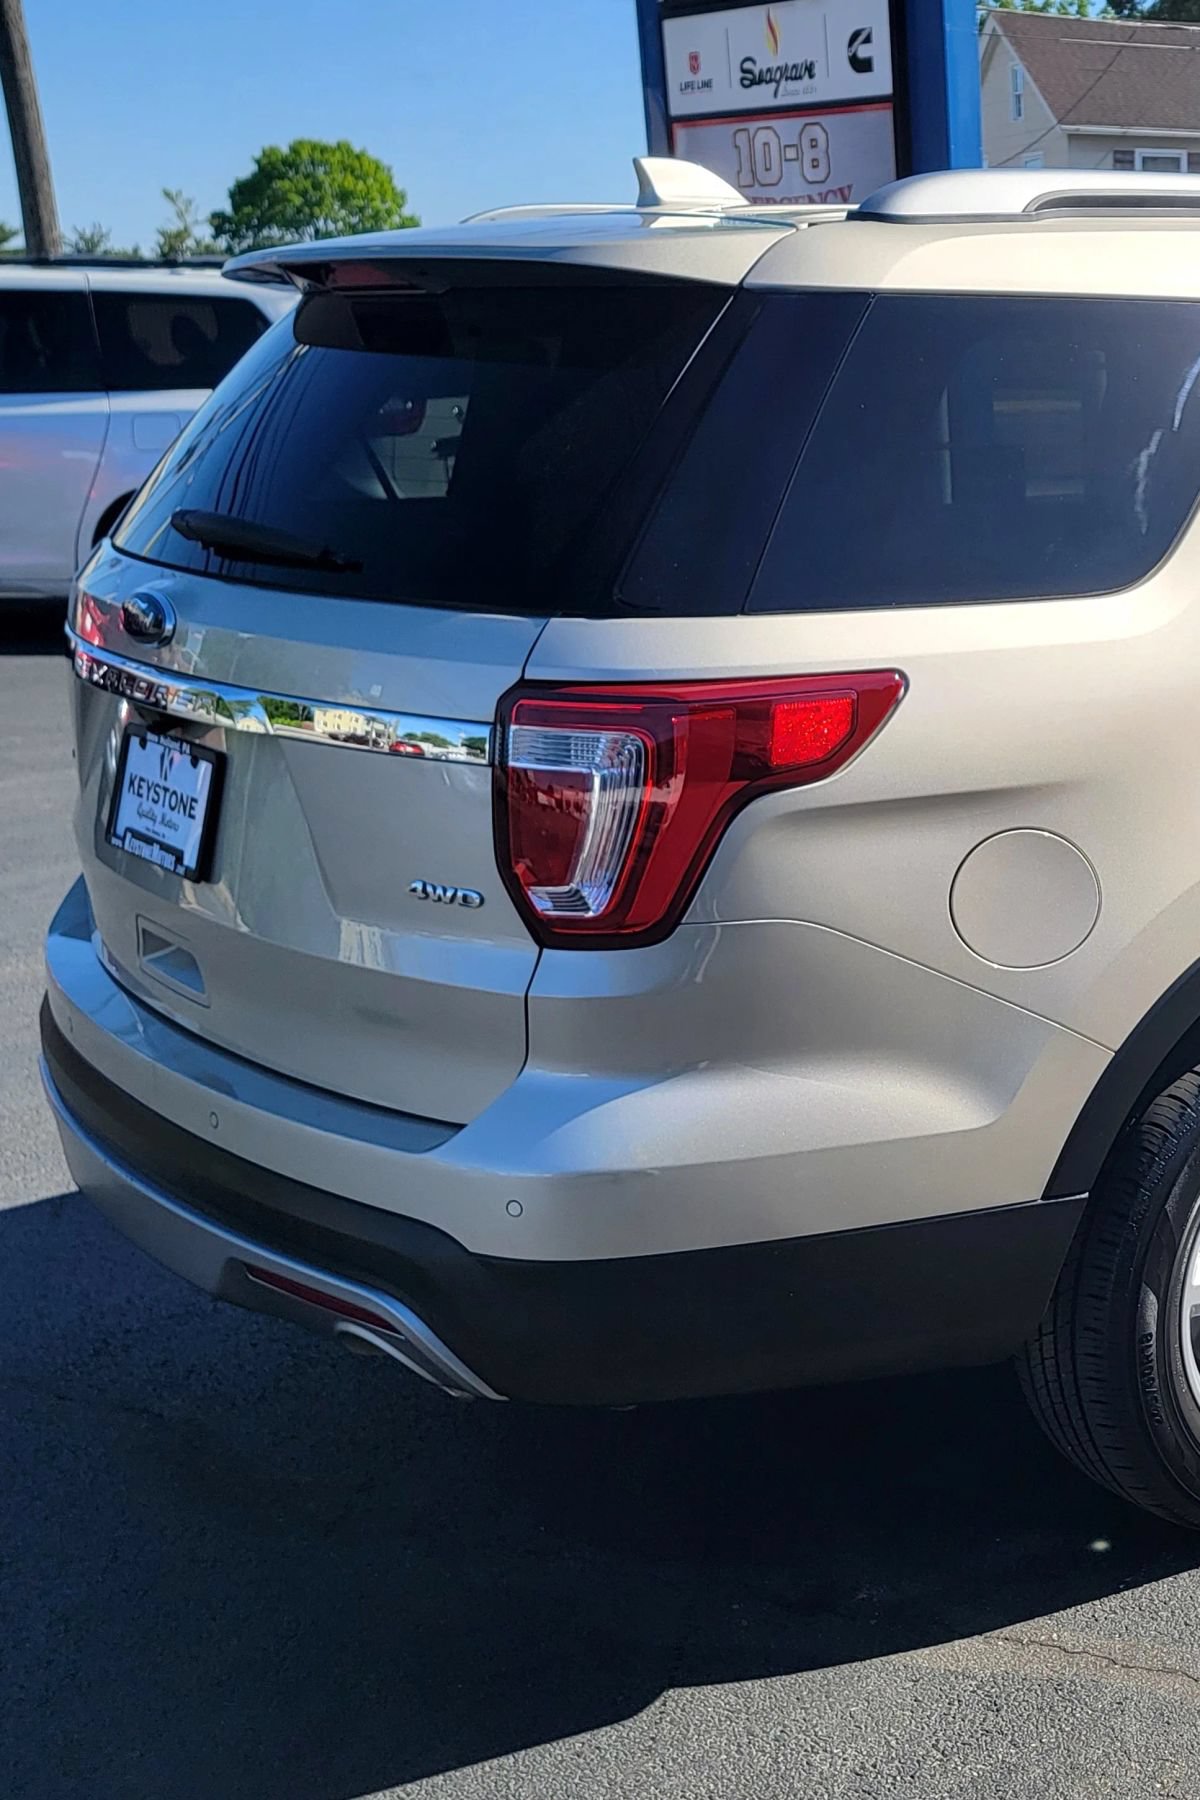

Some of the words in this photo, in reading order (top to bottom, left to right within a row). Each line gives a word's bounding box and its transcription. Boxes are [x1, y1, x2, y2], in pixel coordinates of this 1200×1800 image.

[680, 80, 696, 92] LIFE
[697, 79, 713, 90] LINE
[740, 56, 816, 99] Seagrave
[733, 121, 831, 188] 10-8
[127, 772, 199, 820] KEYSTONE
[408, 879, 485, 909] 4WD
